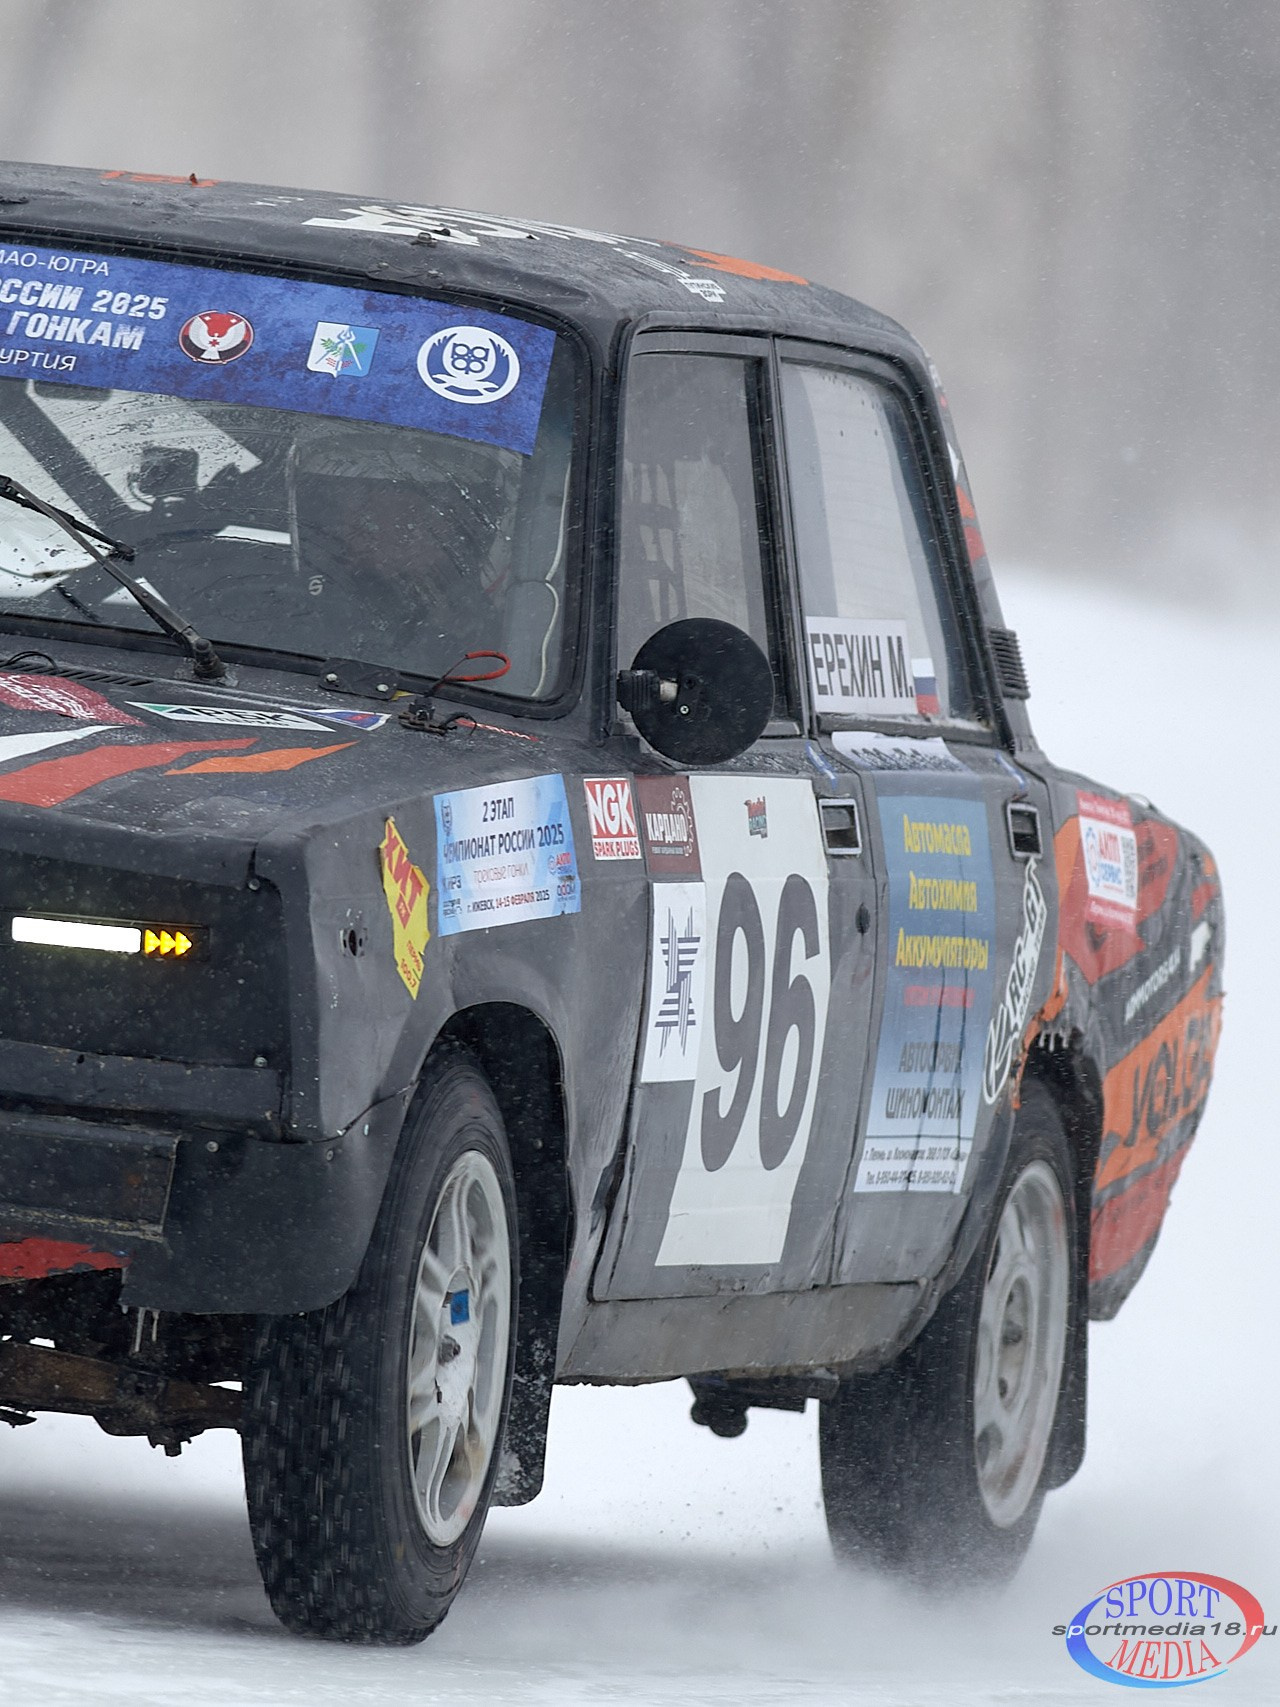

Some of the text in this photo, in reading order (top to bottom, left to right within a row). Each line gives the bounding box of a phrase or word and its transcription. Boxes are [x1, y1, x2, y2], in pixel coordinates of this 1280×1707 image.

[91, 289, 169, 320] 2025
[5, 310, 146, 350] ГОНКАМ
[810, 633, 914, 698] ЕРЕХИН М.
[482, 797, 515, 823] 2 ЭТАП
[586, 782, 636, 836] NGK
[443, 823, 565, 864] ЧЕМПИОНАТ РОССИИ 2025
[593, 841, 615, 857] SPARK
[615, 840, 639, 857] PLUGS
[902, 813, 972, 857] Автомасла
[908, 870, 978, 913] Автохимия
[895, 927, 989, 971] Аккумуляторы
[700, 871, 821, 1172] 96
[898, 1041, 963, 1073] АВТОСРВИ
